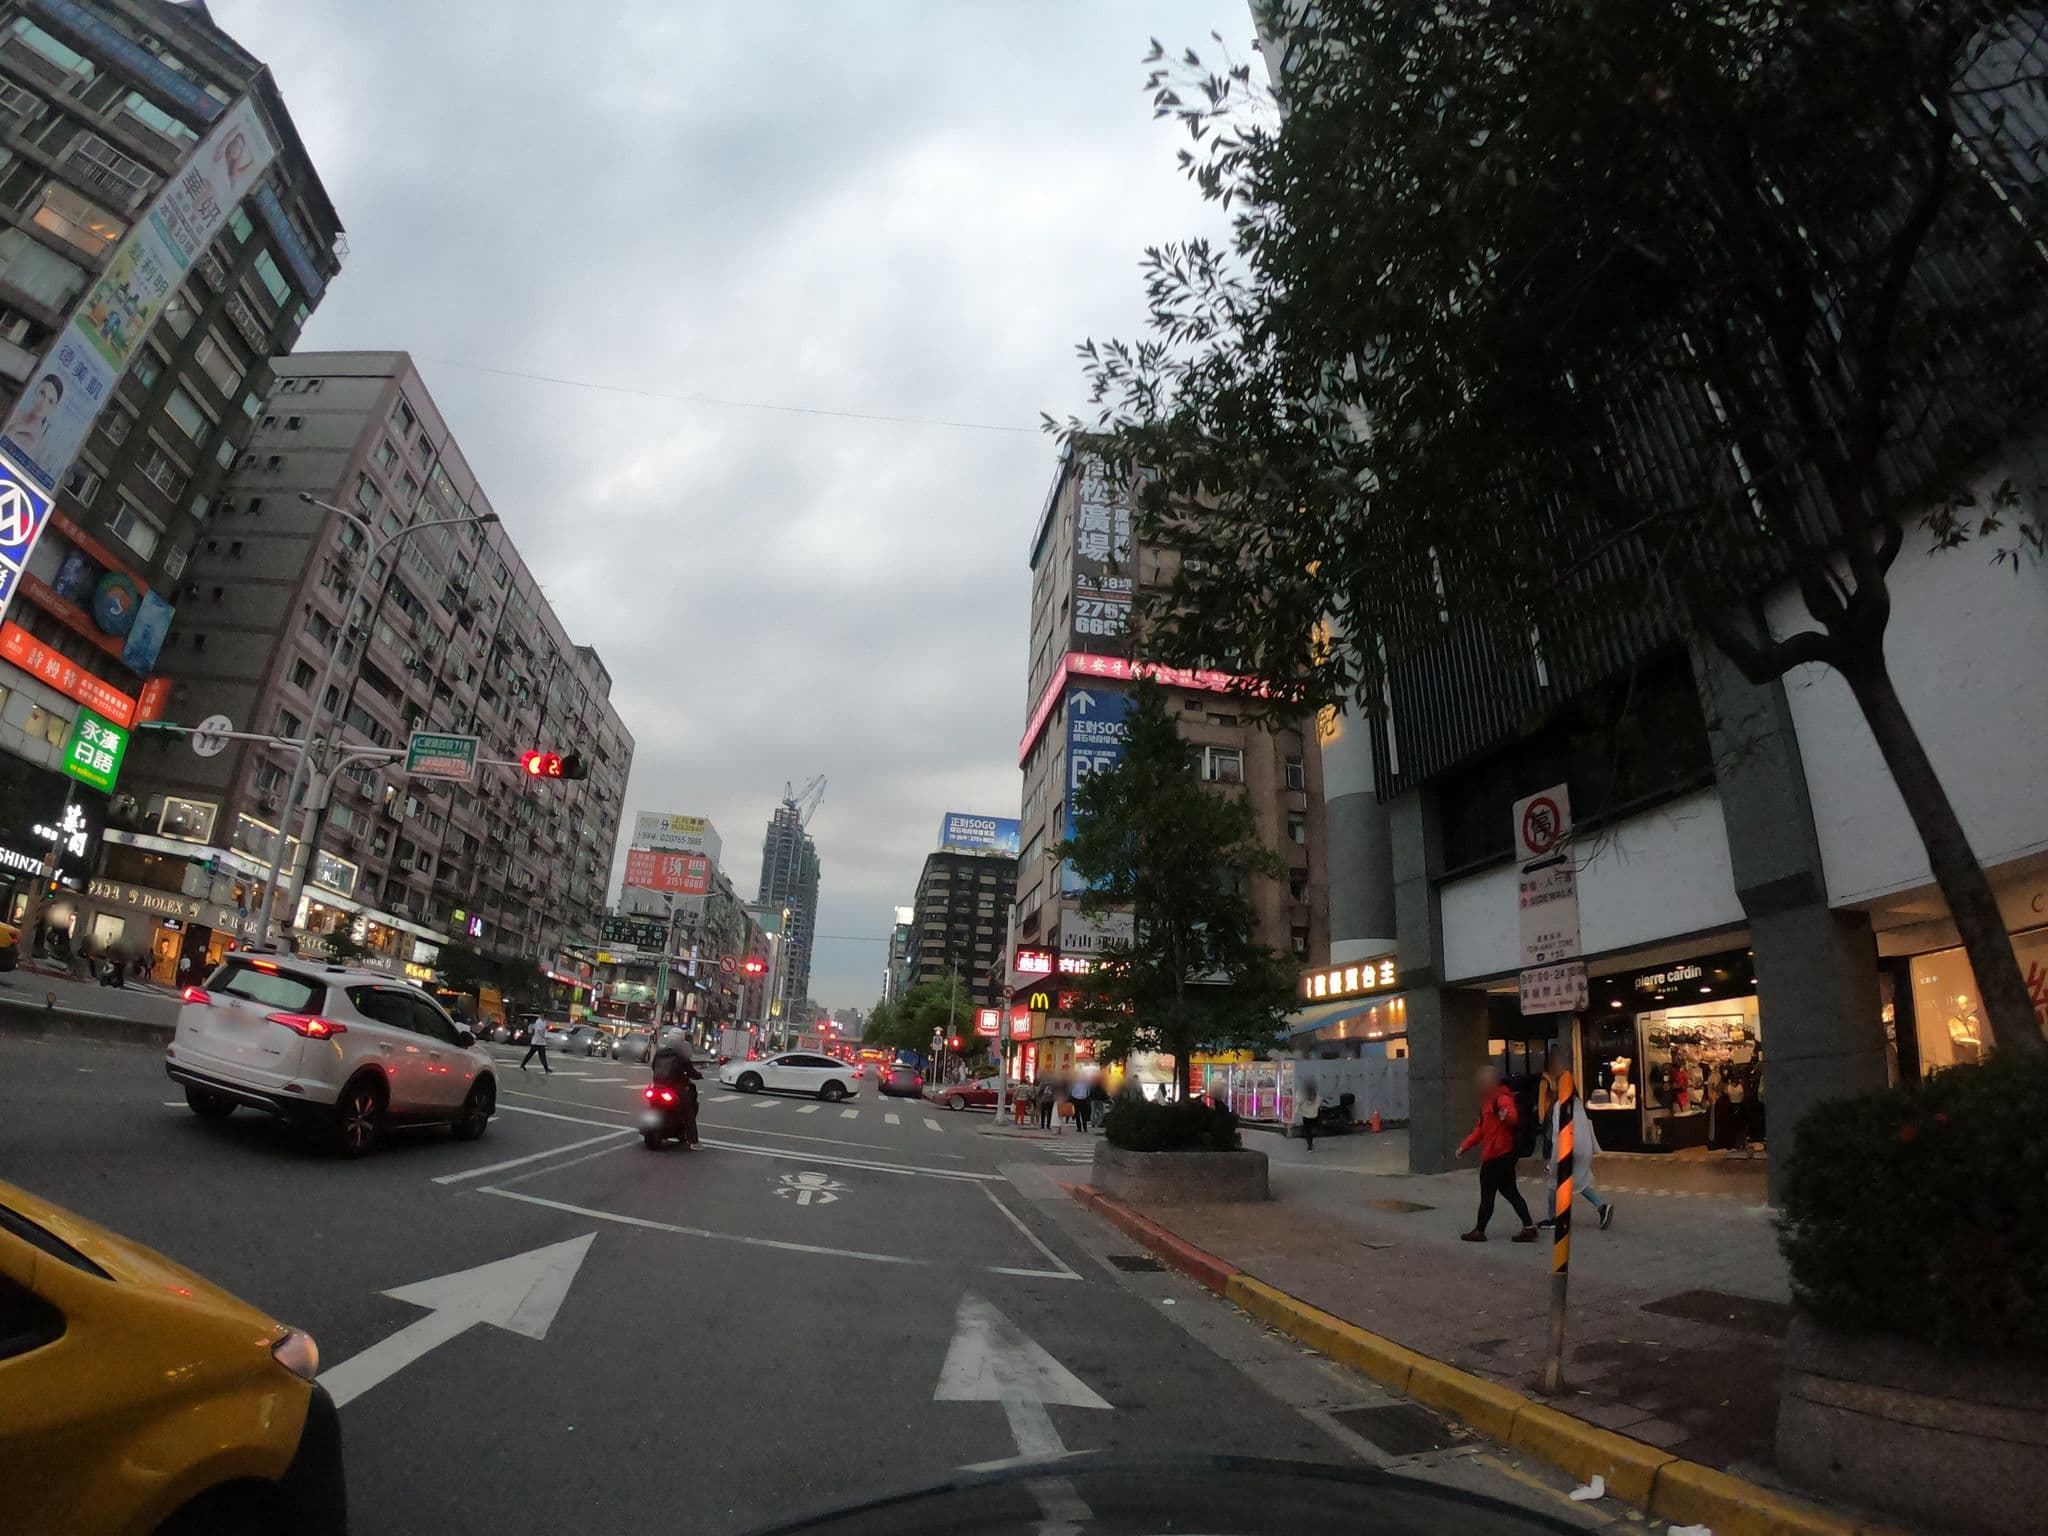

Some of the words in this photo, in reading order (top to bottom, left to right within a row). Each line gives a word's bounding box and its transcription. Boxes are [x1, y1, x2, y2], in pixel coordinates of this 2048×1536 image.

[80, 719, 121, 753] 永漢
[74, 741, 114, 774] 日語
[951, 817, 996, 830] 正對SOGO
[142, 894, 184, 914] ROLEX
[1634, 973, 1666, 991] pierre
[1666, 964, 1702, 983] cardin
